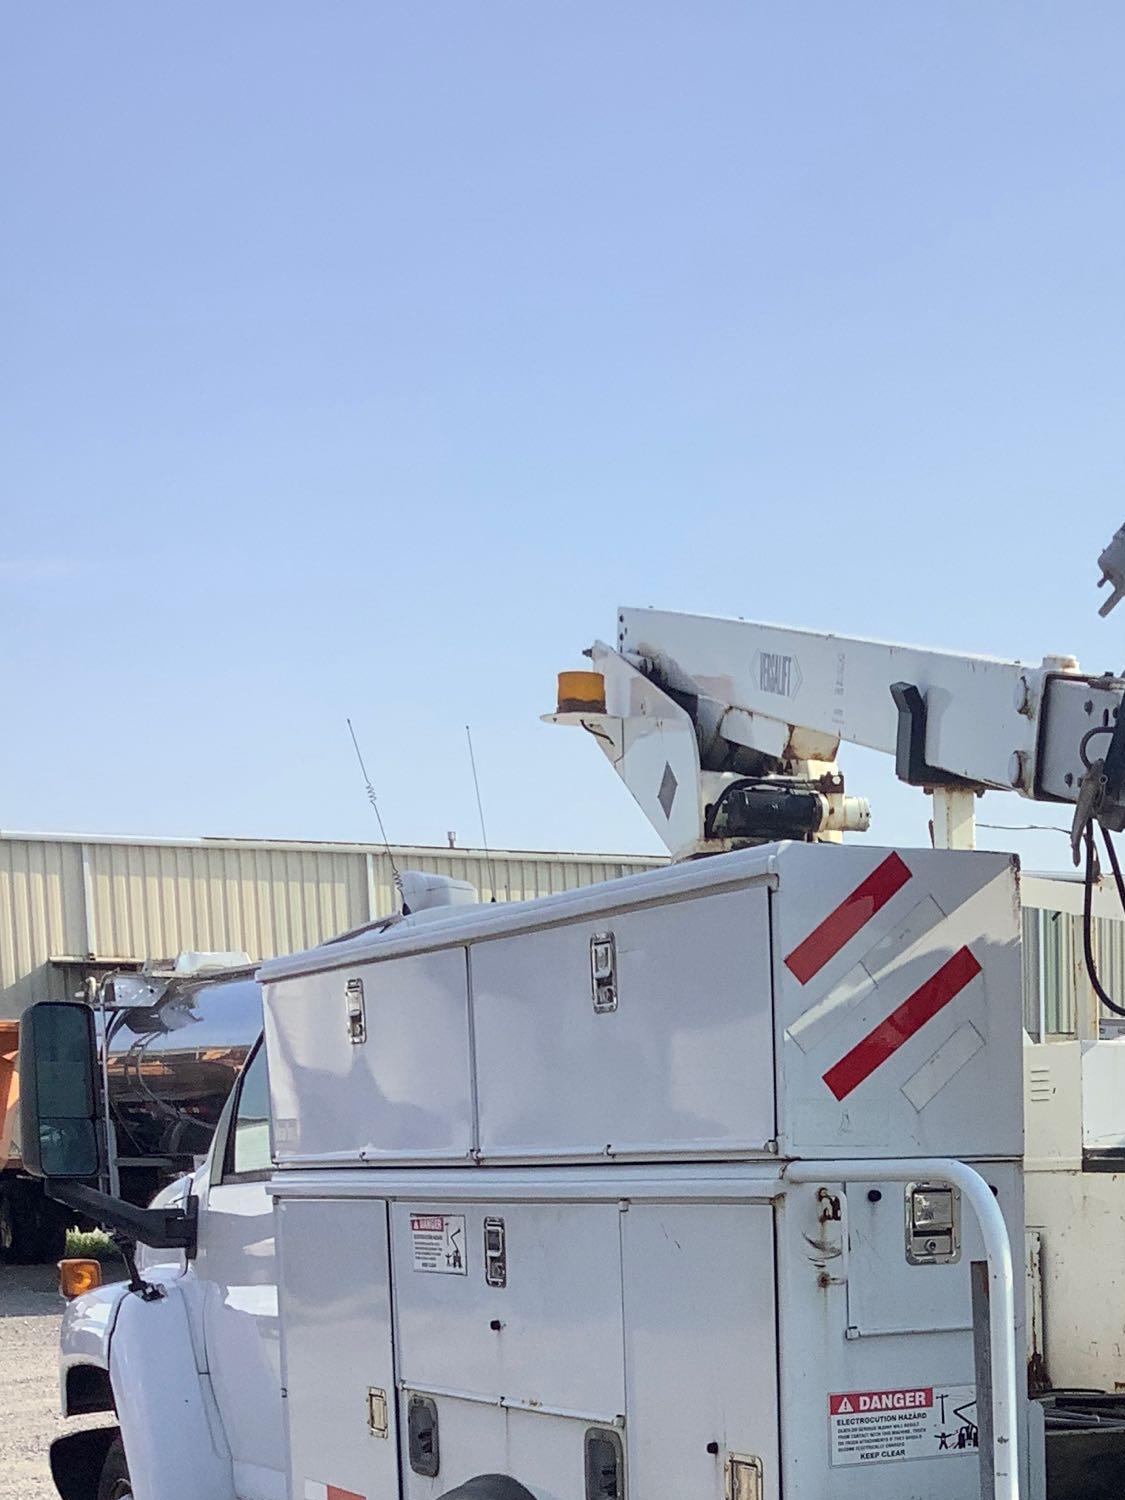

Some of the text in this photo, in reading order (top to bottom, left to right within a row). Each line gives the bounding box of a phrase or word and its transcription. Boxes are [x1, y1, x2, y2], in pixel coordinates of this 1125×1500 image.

[760, 652, 792, 697] VERSALIFT
[859, 1391, 926, 1410] DANGER
[837, 1416, 897, 1426] ELECTROCUTION
[881, 1450, 905, 1458] CLEAR
